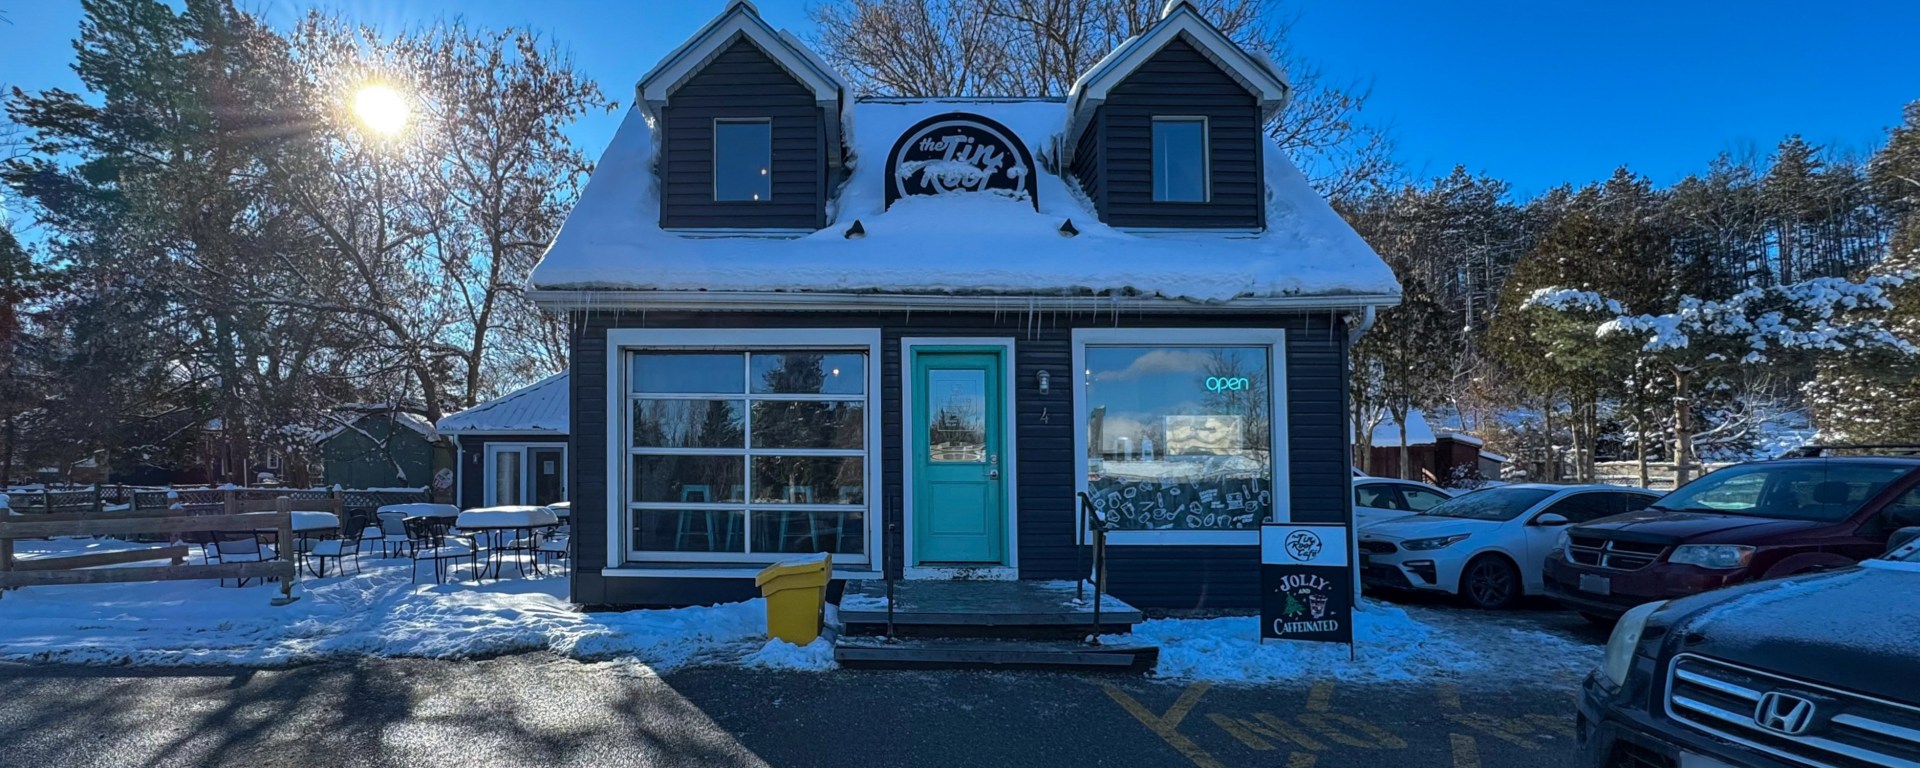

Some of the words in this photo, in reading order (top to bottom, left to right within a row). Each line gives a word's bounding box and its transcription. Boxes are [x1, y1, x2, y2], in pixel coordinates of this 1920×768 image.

[919, 137, 945, 152] the
[941, 134, 999, 165] Tin
[1205, 376, 1249, 394] open
[1039, 407, 1049, 424] 4
[1280, 574, 1330, 591] JOLLY
[1273, 618, 1338, 635] CAFFEINATED
